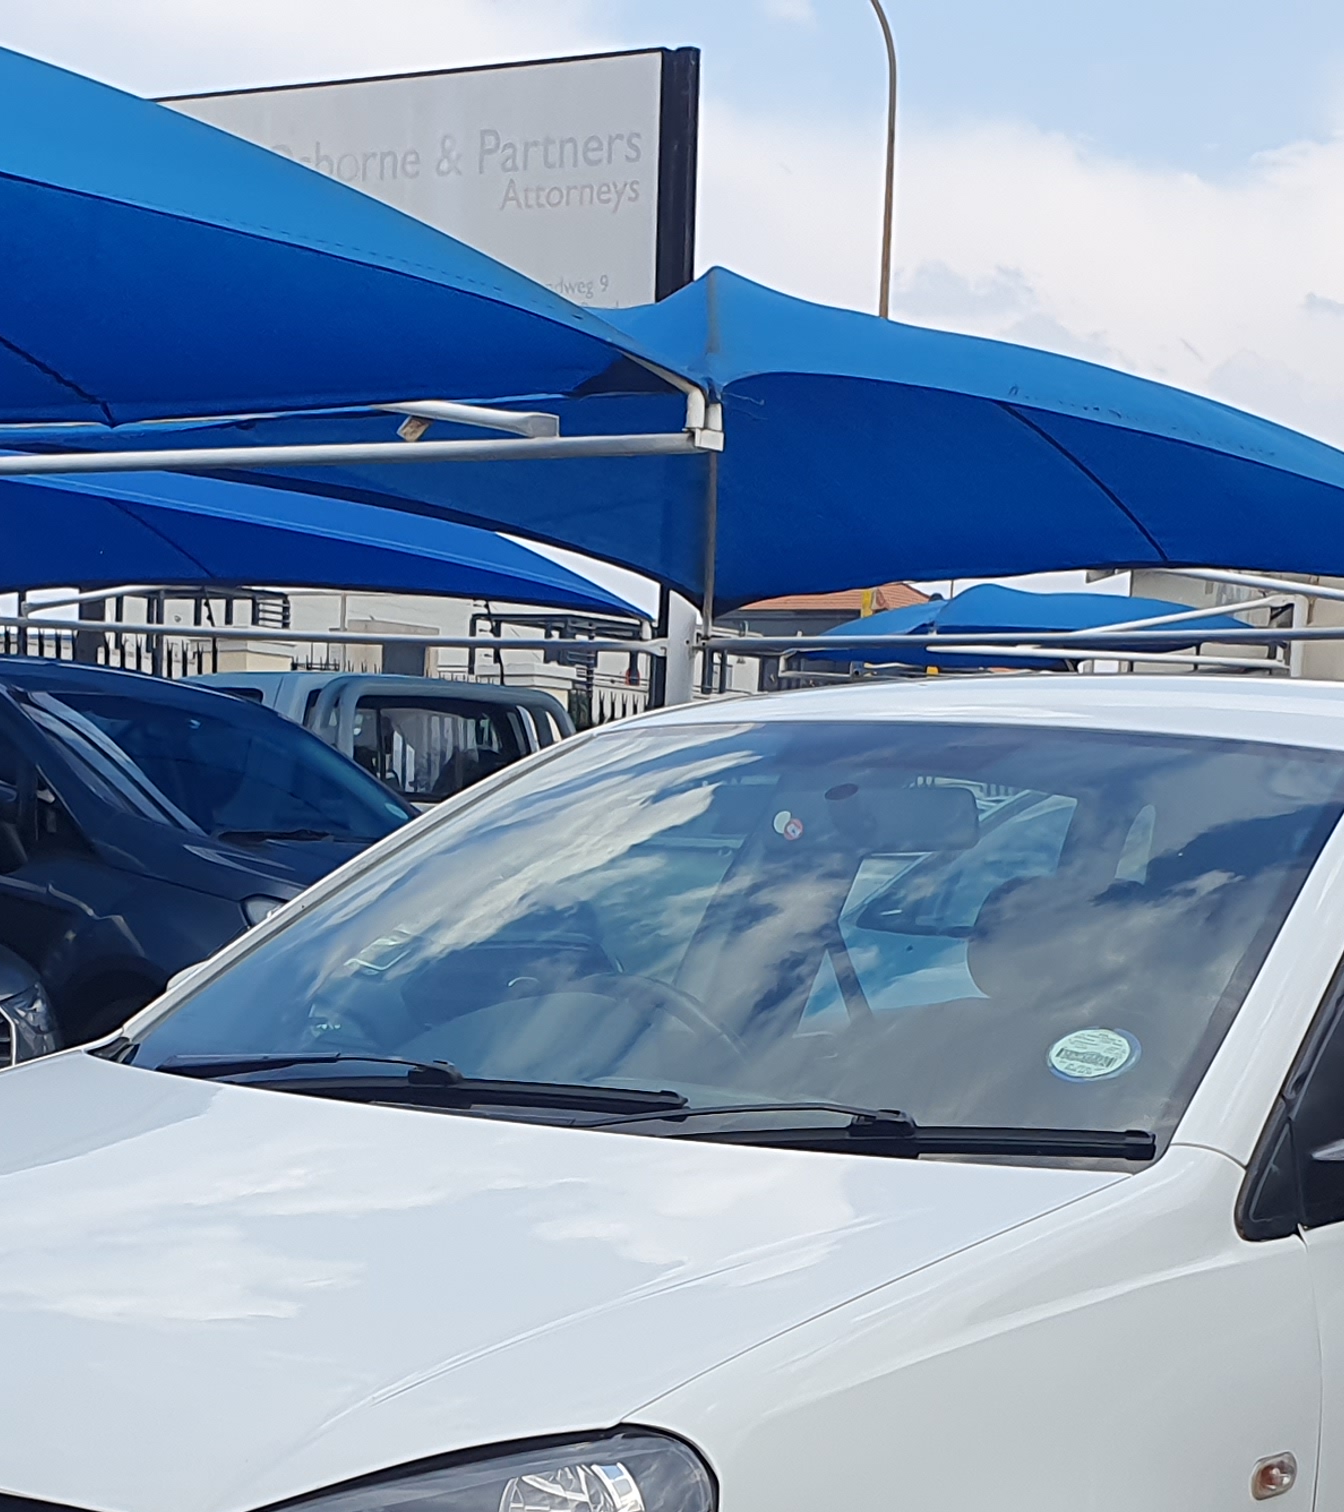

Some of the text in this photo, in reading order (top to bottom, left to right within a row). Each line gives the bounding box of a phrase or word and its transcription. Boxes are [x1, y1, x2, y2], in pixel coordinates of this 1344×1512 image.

[271, 129, 643, 182] borne & Partners
[500, 178, 641, 213] Attorneys
[599, 274, 610, 292] 9
